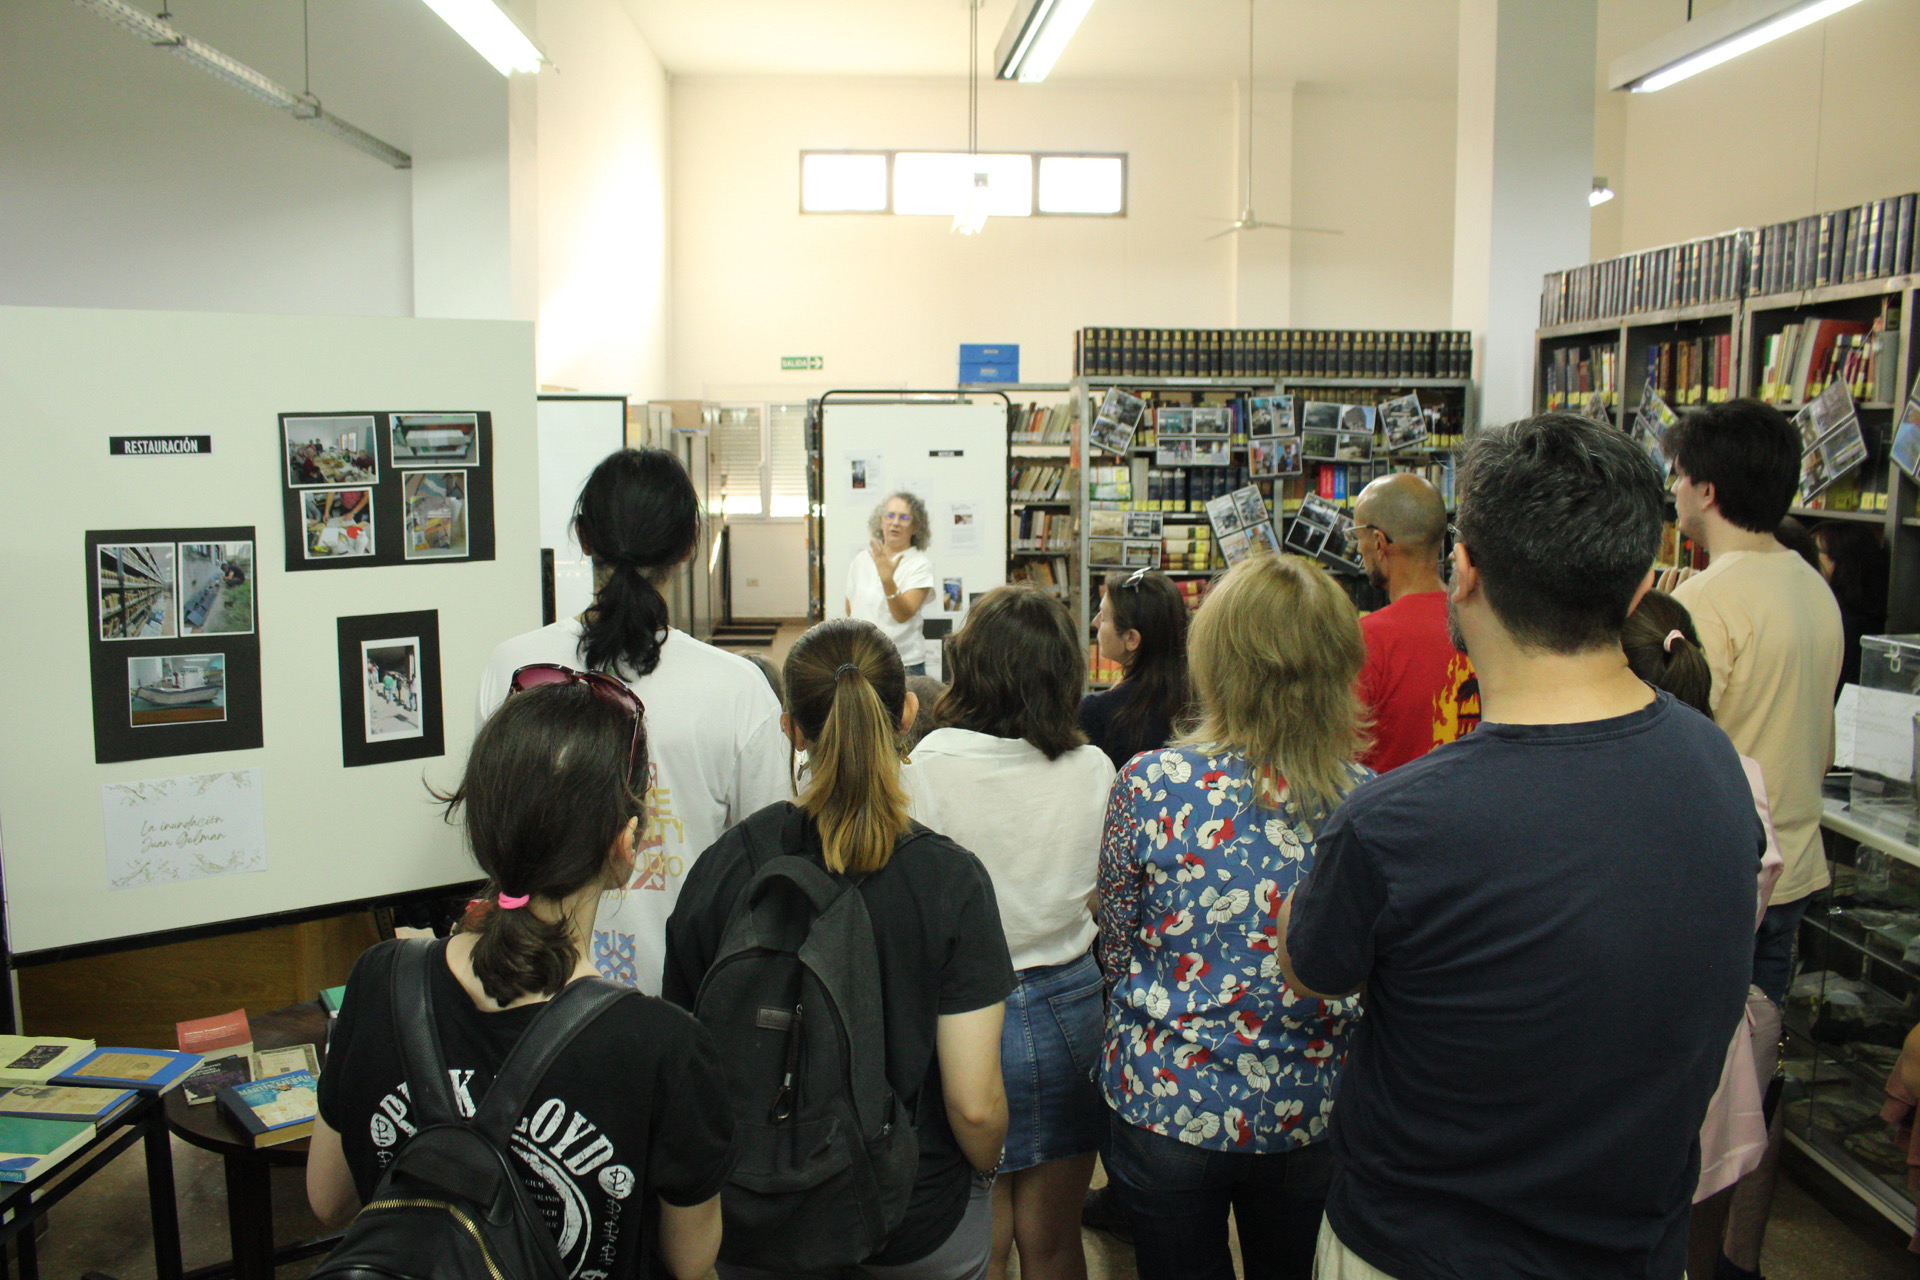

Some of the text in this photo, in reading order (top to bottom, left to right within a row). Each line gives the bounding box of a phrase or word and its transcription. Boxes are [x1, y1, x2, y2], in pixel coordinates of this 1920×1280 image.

[124, 437, 198, 454] RESTAURACIÓN
[141, 819, 156, 837] La
[140, 829, 226, 854] Juan Gelman
[634, 852, 684, 877] UDIO
[379, 1068, 614, 1176] PK OYD
